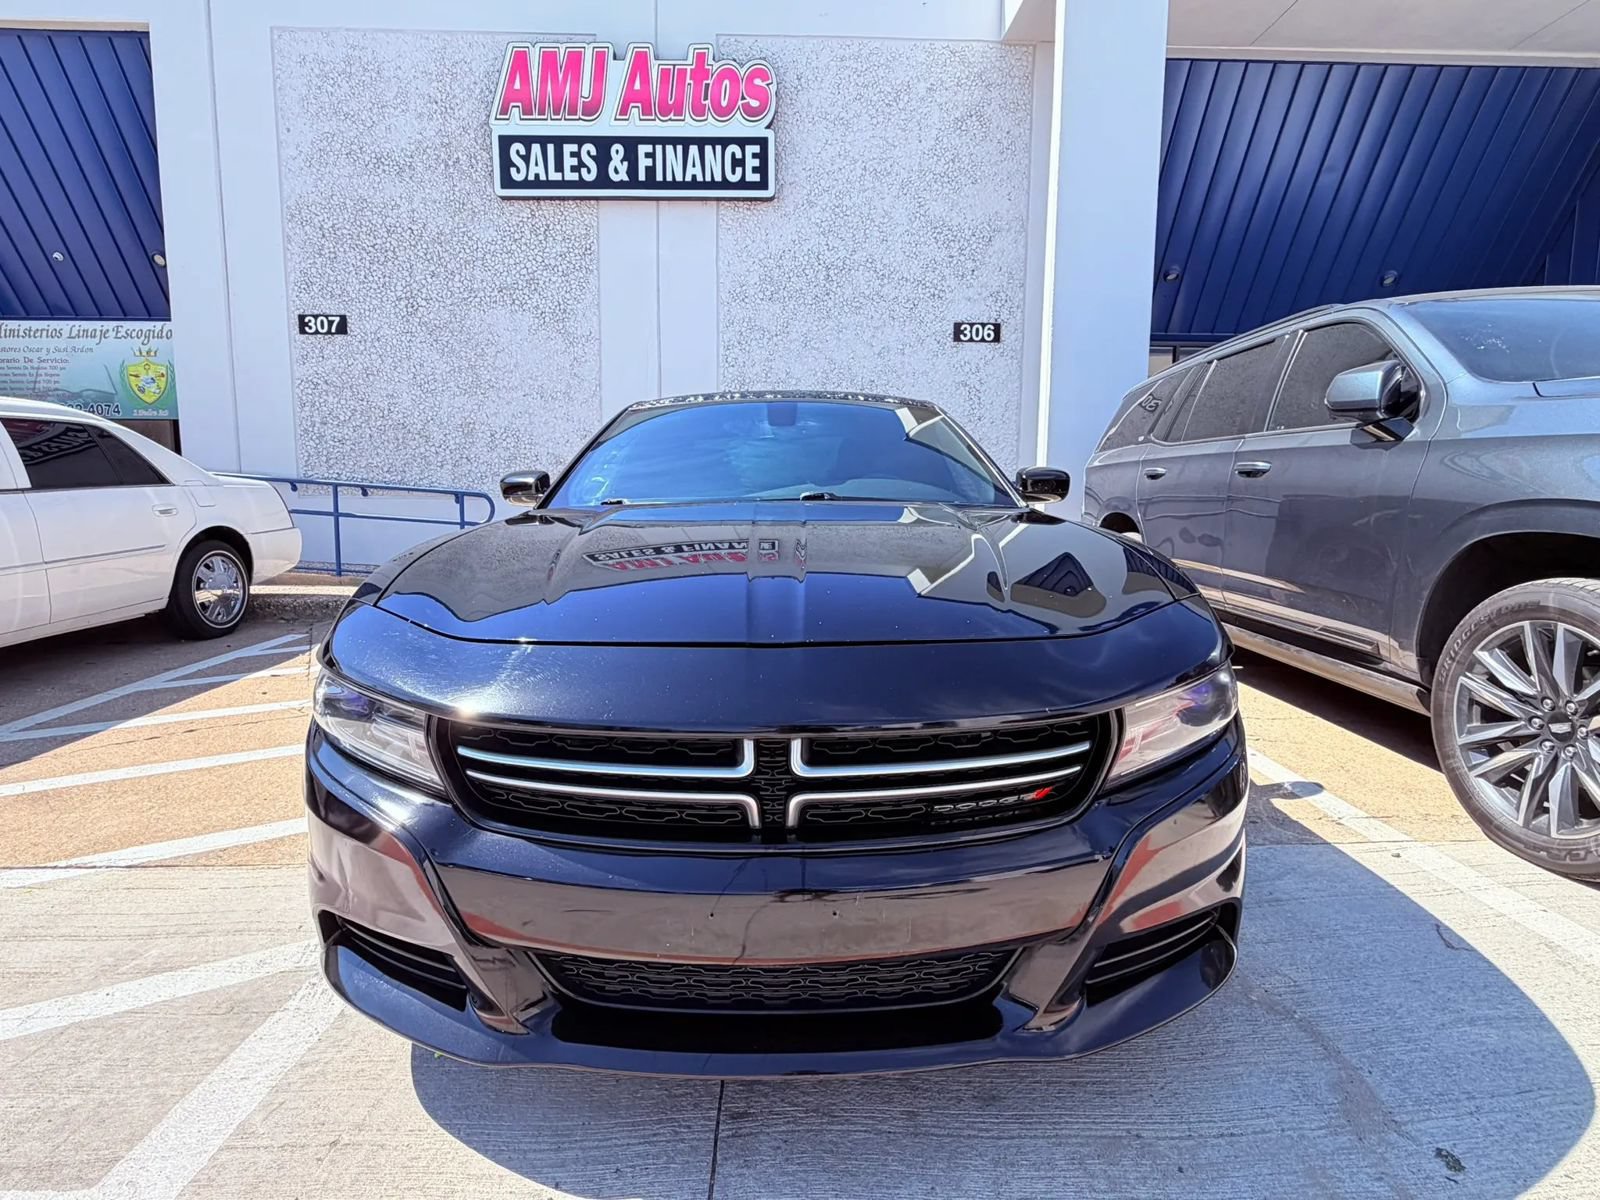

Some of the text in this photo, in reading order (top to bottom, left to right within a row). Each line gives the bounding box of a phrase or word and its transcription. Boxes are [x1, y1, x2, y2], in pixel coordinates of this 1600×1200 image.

[497, 47, 774, 122] AMJ Autos
[509, 142, 761, 183] SALES & FINANCE
[67, 323, 109, 346] Linaje
[112, 322, 173, 346] Escogido
[304, 316, 340, 333] 307
[960, 324, 995, 341] 306
[23, 356, 33, 364] De
